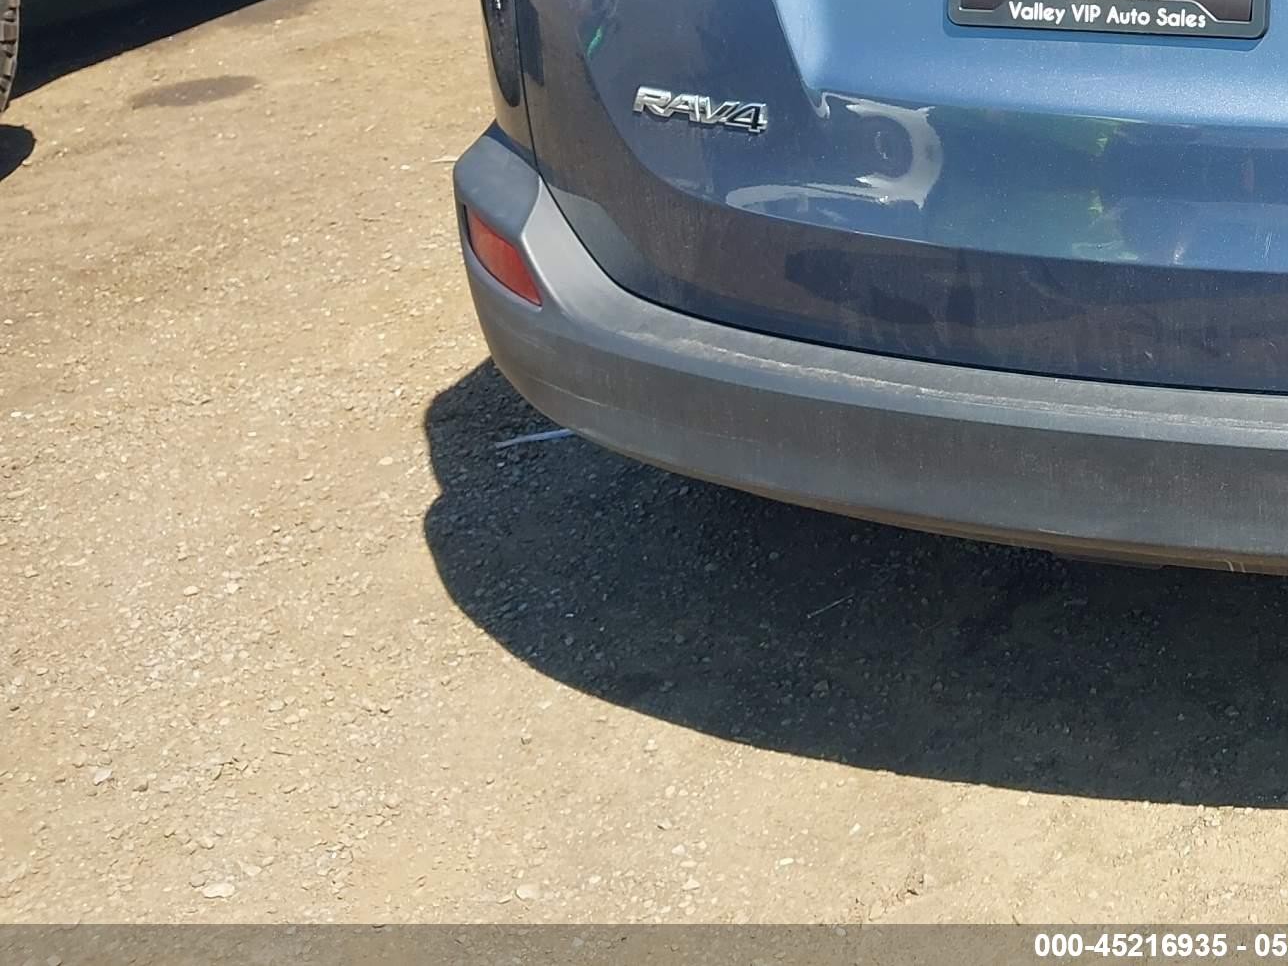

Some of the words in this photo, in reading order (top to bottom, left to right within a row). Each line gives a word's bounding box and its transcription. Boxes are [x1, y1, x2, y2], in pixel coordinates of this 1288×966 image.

[1008, 0, 1066, 24] Valley
[1071, 4, 1101, 23] VIP
[1106, 6, 1150, 26] Auto
[1156, 7, 1206, 28] Sales
[633, 86, 768, 133] RAV4
